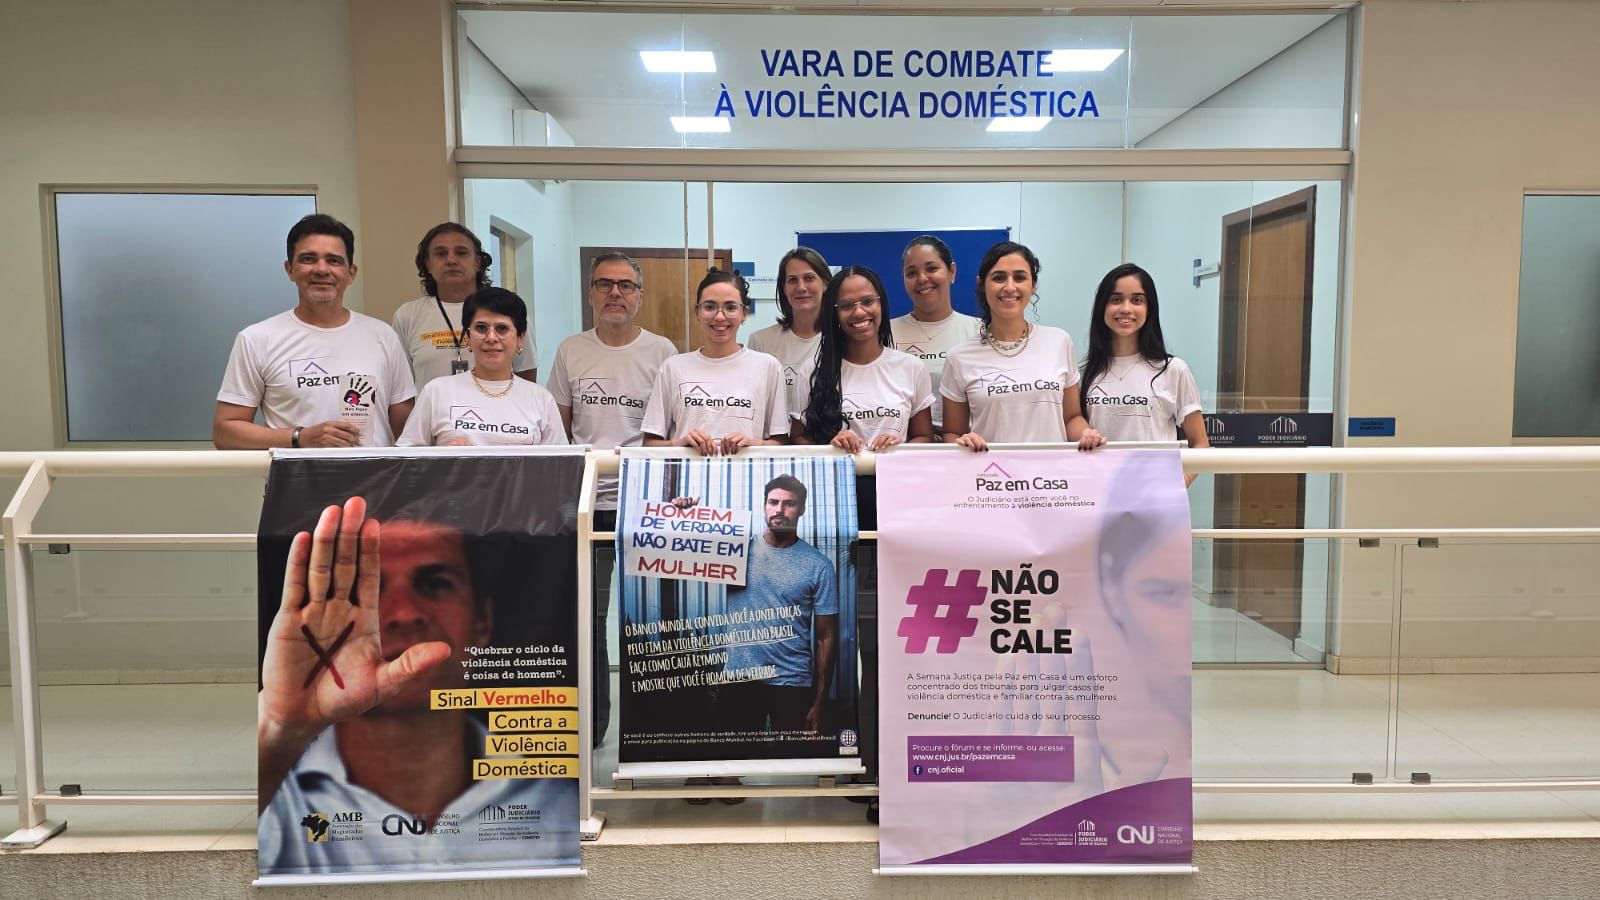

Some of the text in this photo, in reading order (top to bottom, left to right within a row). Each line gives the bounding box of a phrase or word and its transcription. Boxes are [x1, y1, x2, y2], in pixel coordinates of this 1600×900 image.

[761, 49, 1054, 77] VARA DE COMBATE
[715, 83, 1100, 118] À VIOLÊNCIA DOMÉSTICA
[297, 376, 322, 388] Paz
[987, 380, 1060, 396] Paz em Casa
[580, 394, 643, 408] Paz em Casa
[684, 396, 752, 408] Paz em Casa
[1102, 396, 1120, 405] em
[1122, 394, 1148, 405] Casa
[841, 406, 900, 421] az em Casa
[455, 420, 529, 434] Paz em Casa
[976, 477, 1068, 492] Paz em Casa
[645, 502, 732, 522] HOMEM
[953, 502, 1010, 510] enfrentamento
[1018, 501, 1051, 509] violência
[1054, 500, 1095, 508] doméstica
[640, 516, 745, 537] DE VERDADE
[632, 532, 744, 558] NÃO BATE EM
[637, 556, 738, 581] MULHER
[990, 563, 1059, 595] NÃO
[990, 598, 1032, 624] SE
[625, 625, 632, 637] O
[658, 618, 694, 633] MUNDIAL
[694, 614, 729, 630] CONVIDA
[730, 607, 749, 624] VOCÊ
[749, 610, 755, 622] A
[755, 607, 776, 621] UNIR
[776, 604, 802, 621] FORÇAS
[627, 643, 644, 656] PELO
[645, 641, 661, 653] FIM
[662, 639, 672, 651] DA
[673, 633, 714, 650] VIOLÊNCIA
[714, 628, 756, 645] DOMÉSTICA
[757, 627, 769, 640] NO
[990, 628, 1072, 654] CALE
[524, 644, 550, 654] ciclo
[551, 644, 565, 653] da
[461, 657, 568, 668] violência doméstica
[647, 658, 670, 672] COMO
[692, 651, 729, 667] REYMOND
[463, 671, 470, 680] é
[472, 671, 500, 680] coisa
[502, 670, 514, 679] de
[632, 664, 776, 693] E MOSTRE QUE VOCÊ É HOMEM DE VERDADE
[953, 673, 982, 682] Justiça
[984, 673, 1003, 682] pela
[1039, 673, 1060, 681] Casa
[1062, 673, 1067, 681] é
[1086, 673, 1118, 682] esforço
[980, 682, 1018, 690] tribunais
[1020, 684, 1039, 692] para
[1040, 683, 1066, 692] julgar
[1093, 683, 1105, 691] de
[438, 689, 567, 707] Sinal Vermelho
[907, 692, 944, 700] violência
[946, 692, 991, 700] doméstica
[494, 714, 567, 729] Contra a
[908, 712, 951, 720] Denuncie!
[953, 712, 960, 720] O
[962, 712, 1003, 720] Judiciário
[1005, 712, 1030, 720] cuida
[1031, 712, 1043, 720] do
[1063, 714, 1103, 722] processo.
[491, 736, 567, 752] Violência
[912, 753, 1016, 761] www.cnj.jus.br/pazemcasa
[478, 761, 567, 777] Doméstica
[927, 766, 965, 774] cnj.oficial
[332, 812, 363, 822] AMB
[1117, 824, 1154, 844] CNJ
